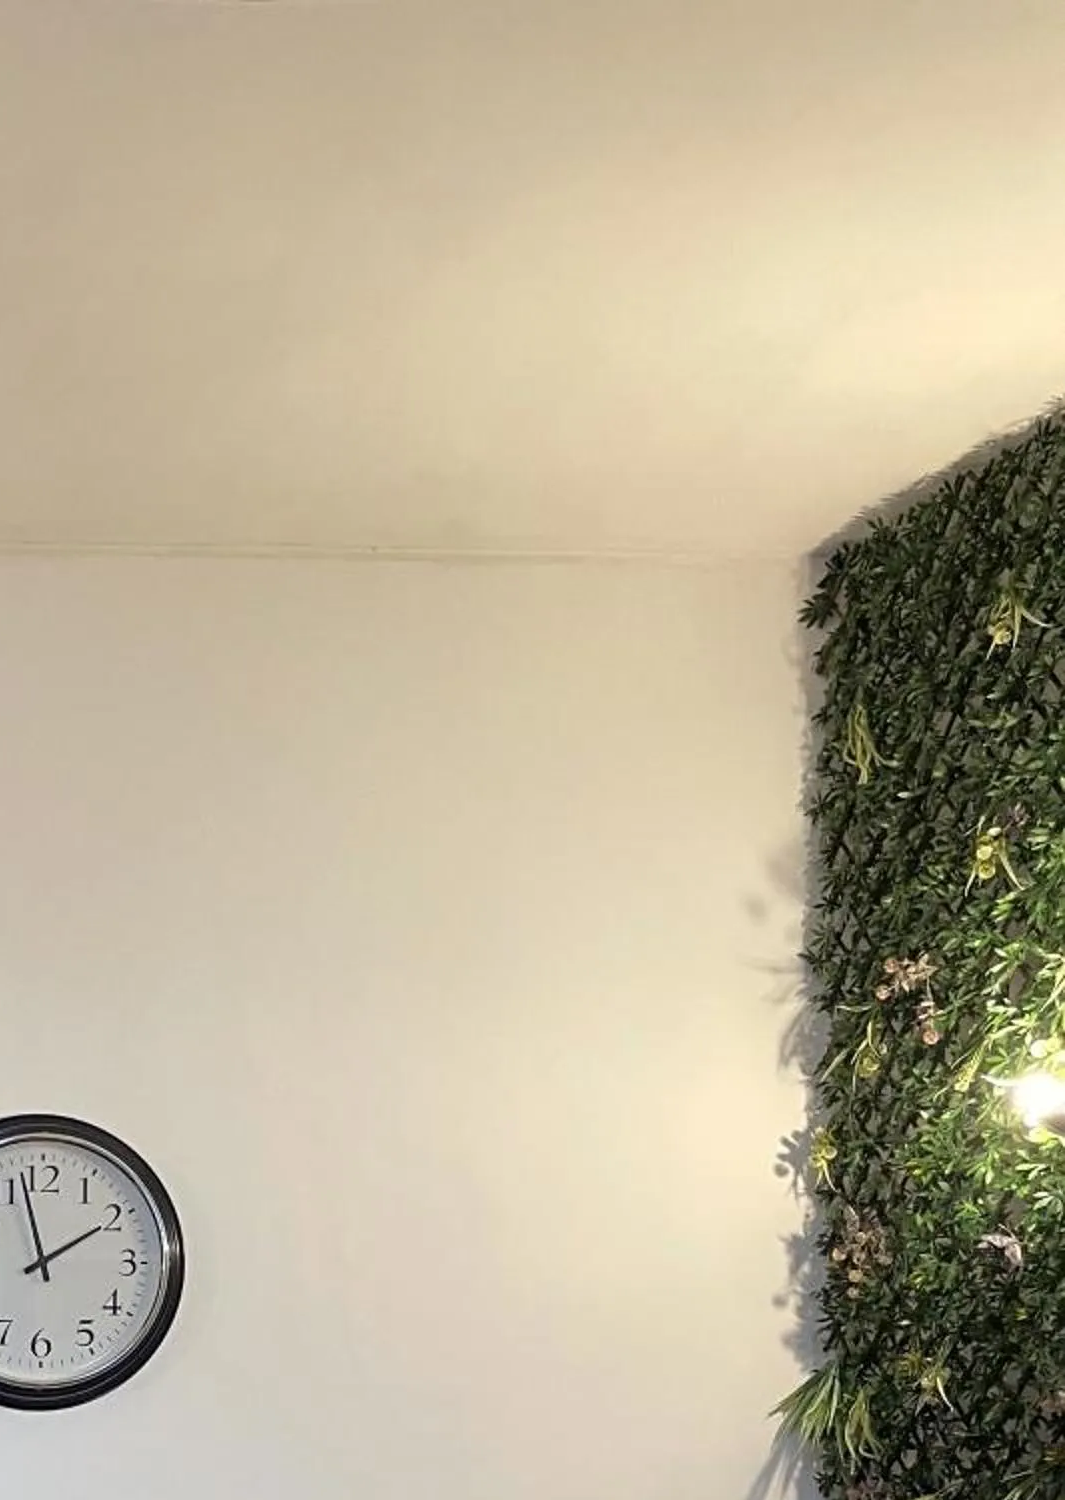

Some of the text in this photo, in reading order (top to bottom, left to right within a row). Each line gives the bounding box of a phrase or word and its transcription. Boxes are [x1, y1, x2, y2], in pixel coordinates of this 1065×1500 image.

[25, 1165, 60, 1193] 12
[79, 1177, 90, 1205] 1
[102, 1203, 122, 1232] 2
[118, 1248, 137, 1277] 3
[102, 1288, 122, 1316] 4
[30, 1328, 53, 1358] 6
[76, 1319, 95, 1347] 5
